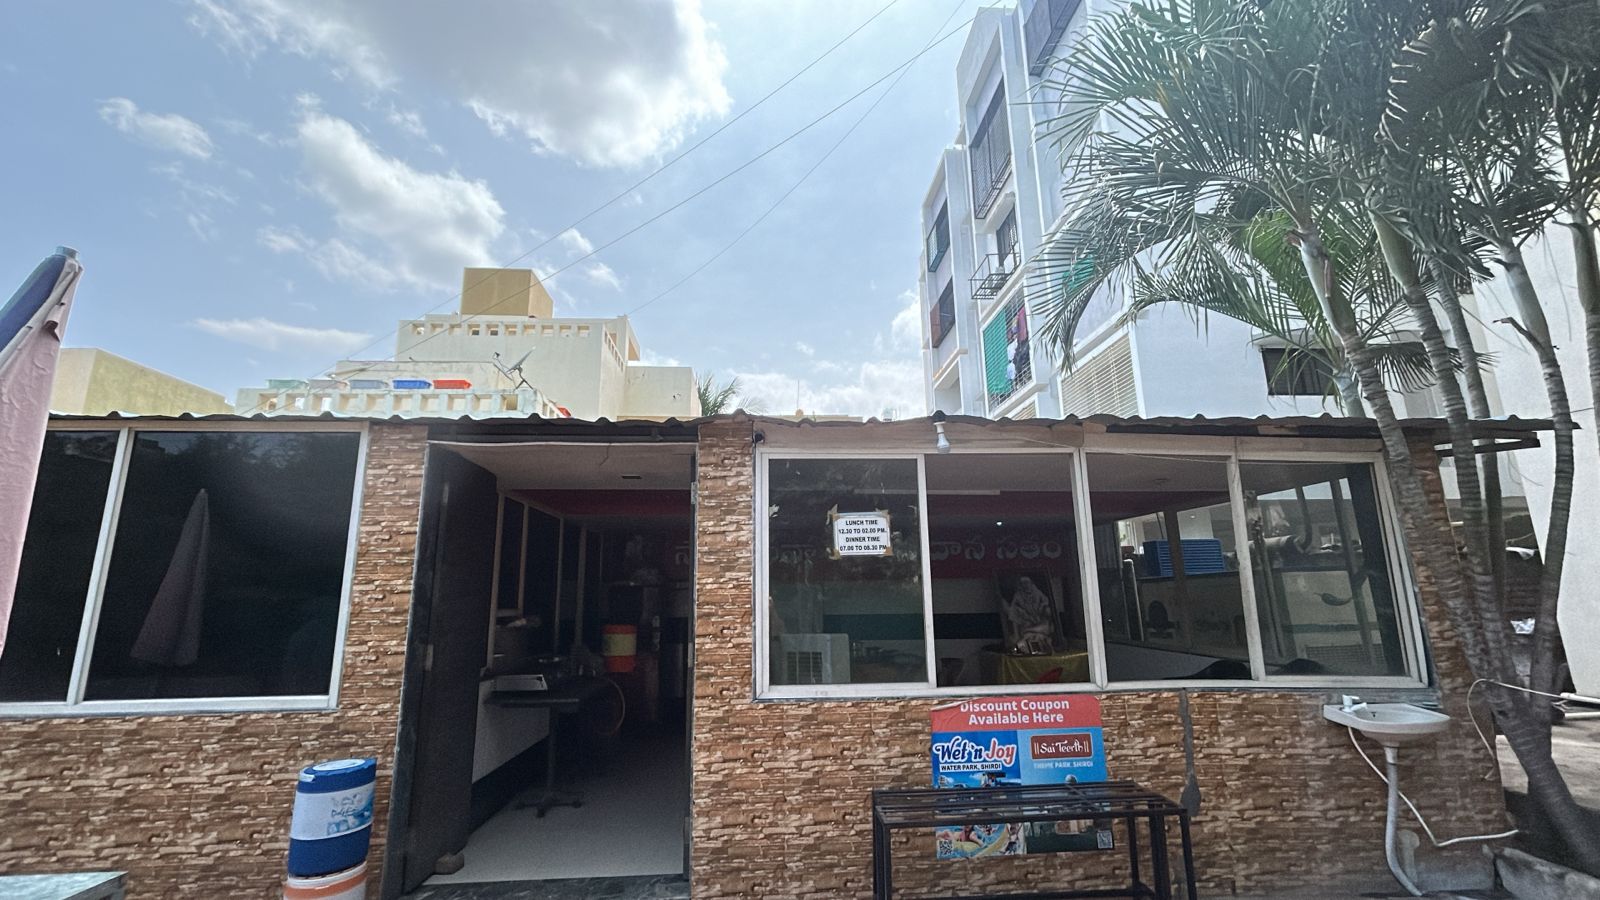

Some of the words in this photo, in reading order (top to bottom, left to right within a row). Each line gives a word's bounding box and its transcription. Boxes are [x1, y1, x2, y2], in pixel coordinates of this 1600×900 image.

[960, 701, 1017, 713] Discount
[1021, 699, 1069, 713] Coupon
[968, 712, 1029, 725] Available
[1032, 711, 1064, 723] Here
[934, 737, 968, 761] Wet
[985, 739, 1016, 765] Joy
[1040, 742, 1055, 754] Sai
[1055, 739, 1083, 753] Teerth
[1072, 760, 1094, 768] SHIRDI
